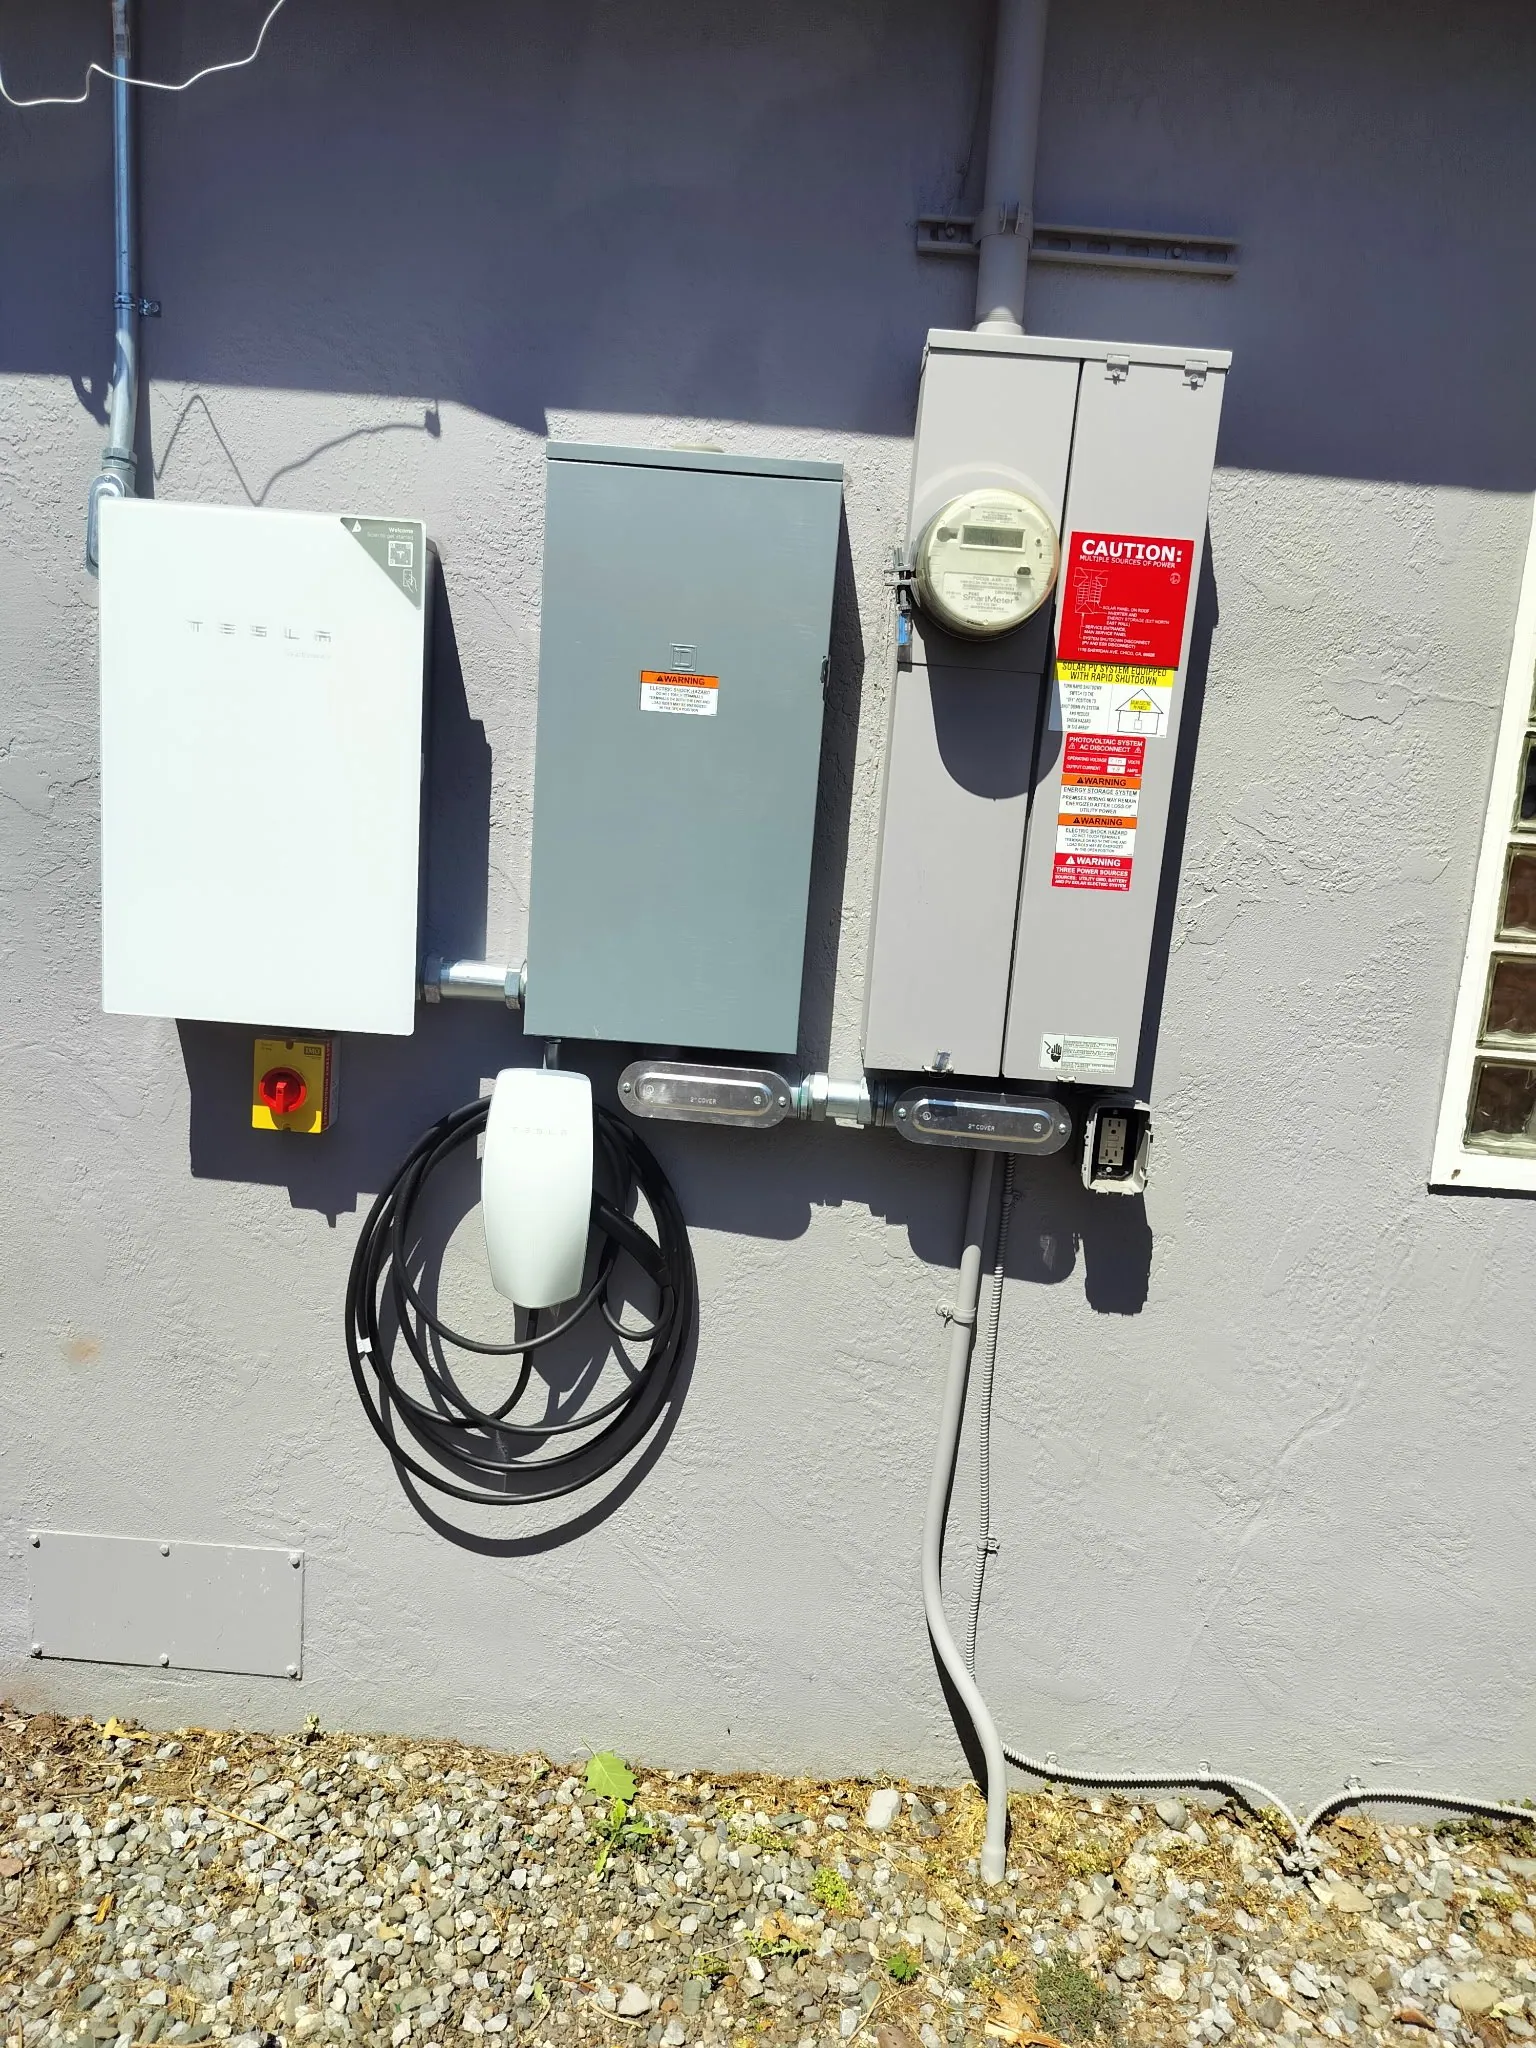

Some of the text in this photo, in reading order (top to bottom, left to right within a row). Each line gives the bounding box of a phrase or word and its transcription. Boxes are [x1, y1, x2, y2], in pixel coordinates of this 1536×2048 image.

[1082, 539, 1182, 563] CAUTION:
[1080, 555, 1109, 563] MULTIPLE
[1111, 558, 1141, 566] SOURCES
[187, 619, 332, 642] TESLA
[1062, 662, 1167, 676] SOLAR PV SYSTEM EQUIPPED
[664, 676, 705, 685] WARNING
[1070, 671, 1157, 685] WITH RAPID SHUTDOWN
[1069, 737, 1116, 745] PHOTOVOLTAIC
[1090, 745, 1131, 753] DISCONNECT
[1084, 777, 1126, 786] WARNING
[1080, 817, 1123, 826] WARNING
[1077, 857, 1121, 866] WARNING
[305, 1047, 320, 1055] IMO
[698, 1097, 717, 1105] COVER
